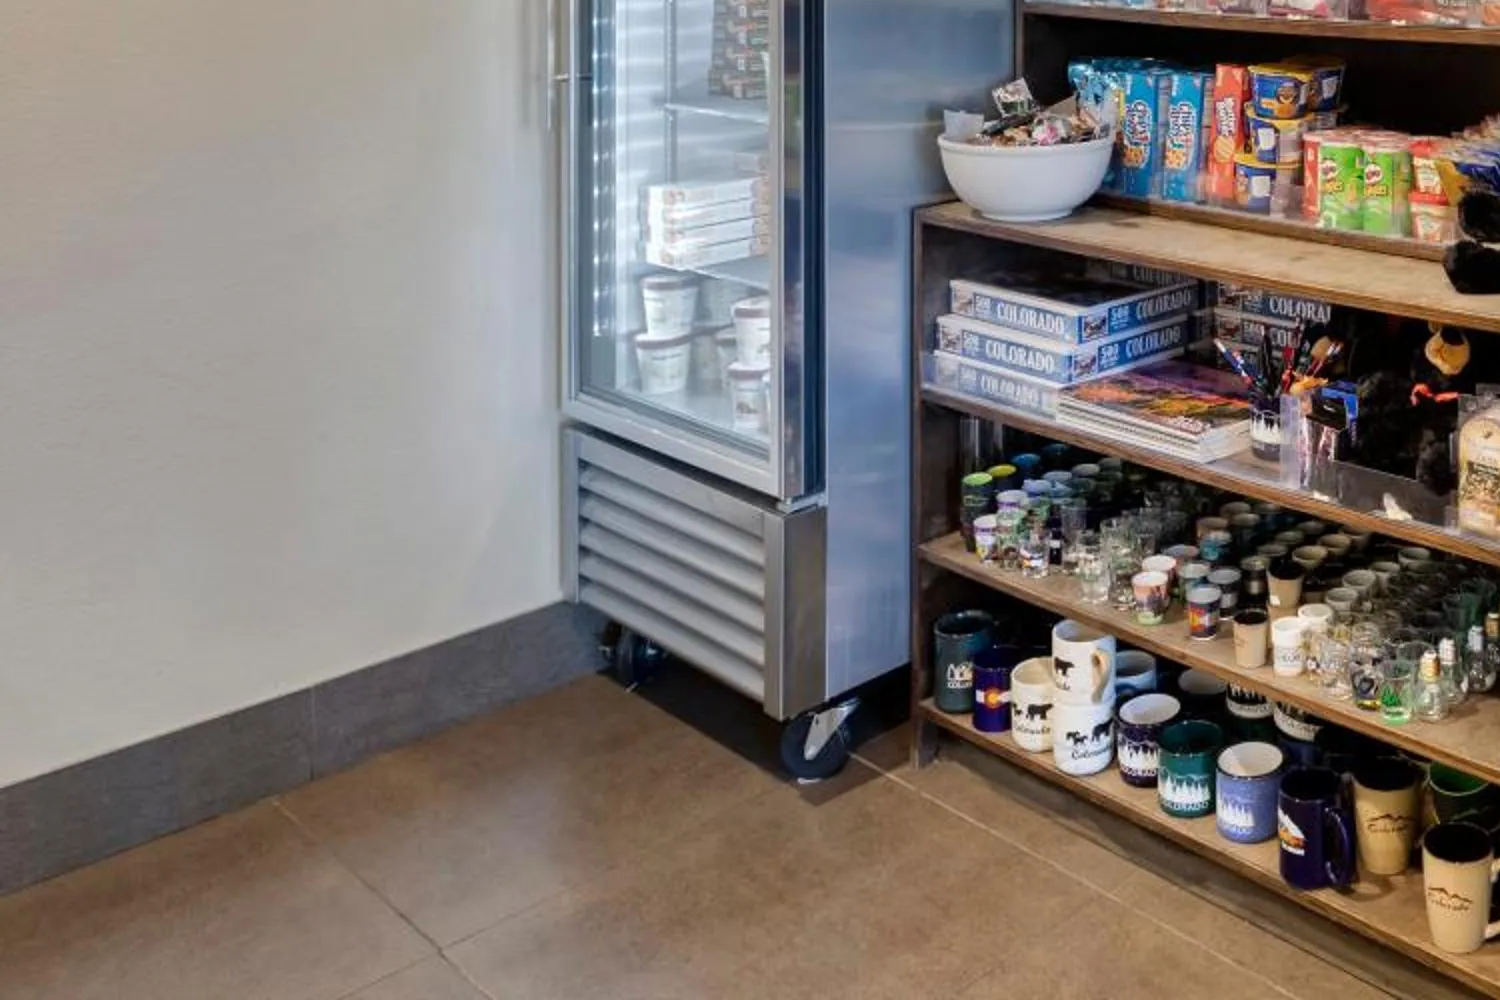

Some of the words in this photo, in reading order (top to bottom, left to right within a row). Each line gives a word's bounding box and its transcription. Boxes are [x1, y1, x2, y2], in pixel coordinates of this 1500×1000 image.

[996, 302, 1065, 334] COLORADO
[1136, 288, 1191, 321] COLORADO
[985, 339, 1055, 374] COLORADO
[1125, 325, 1181, 358] COLORADO
